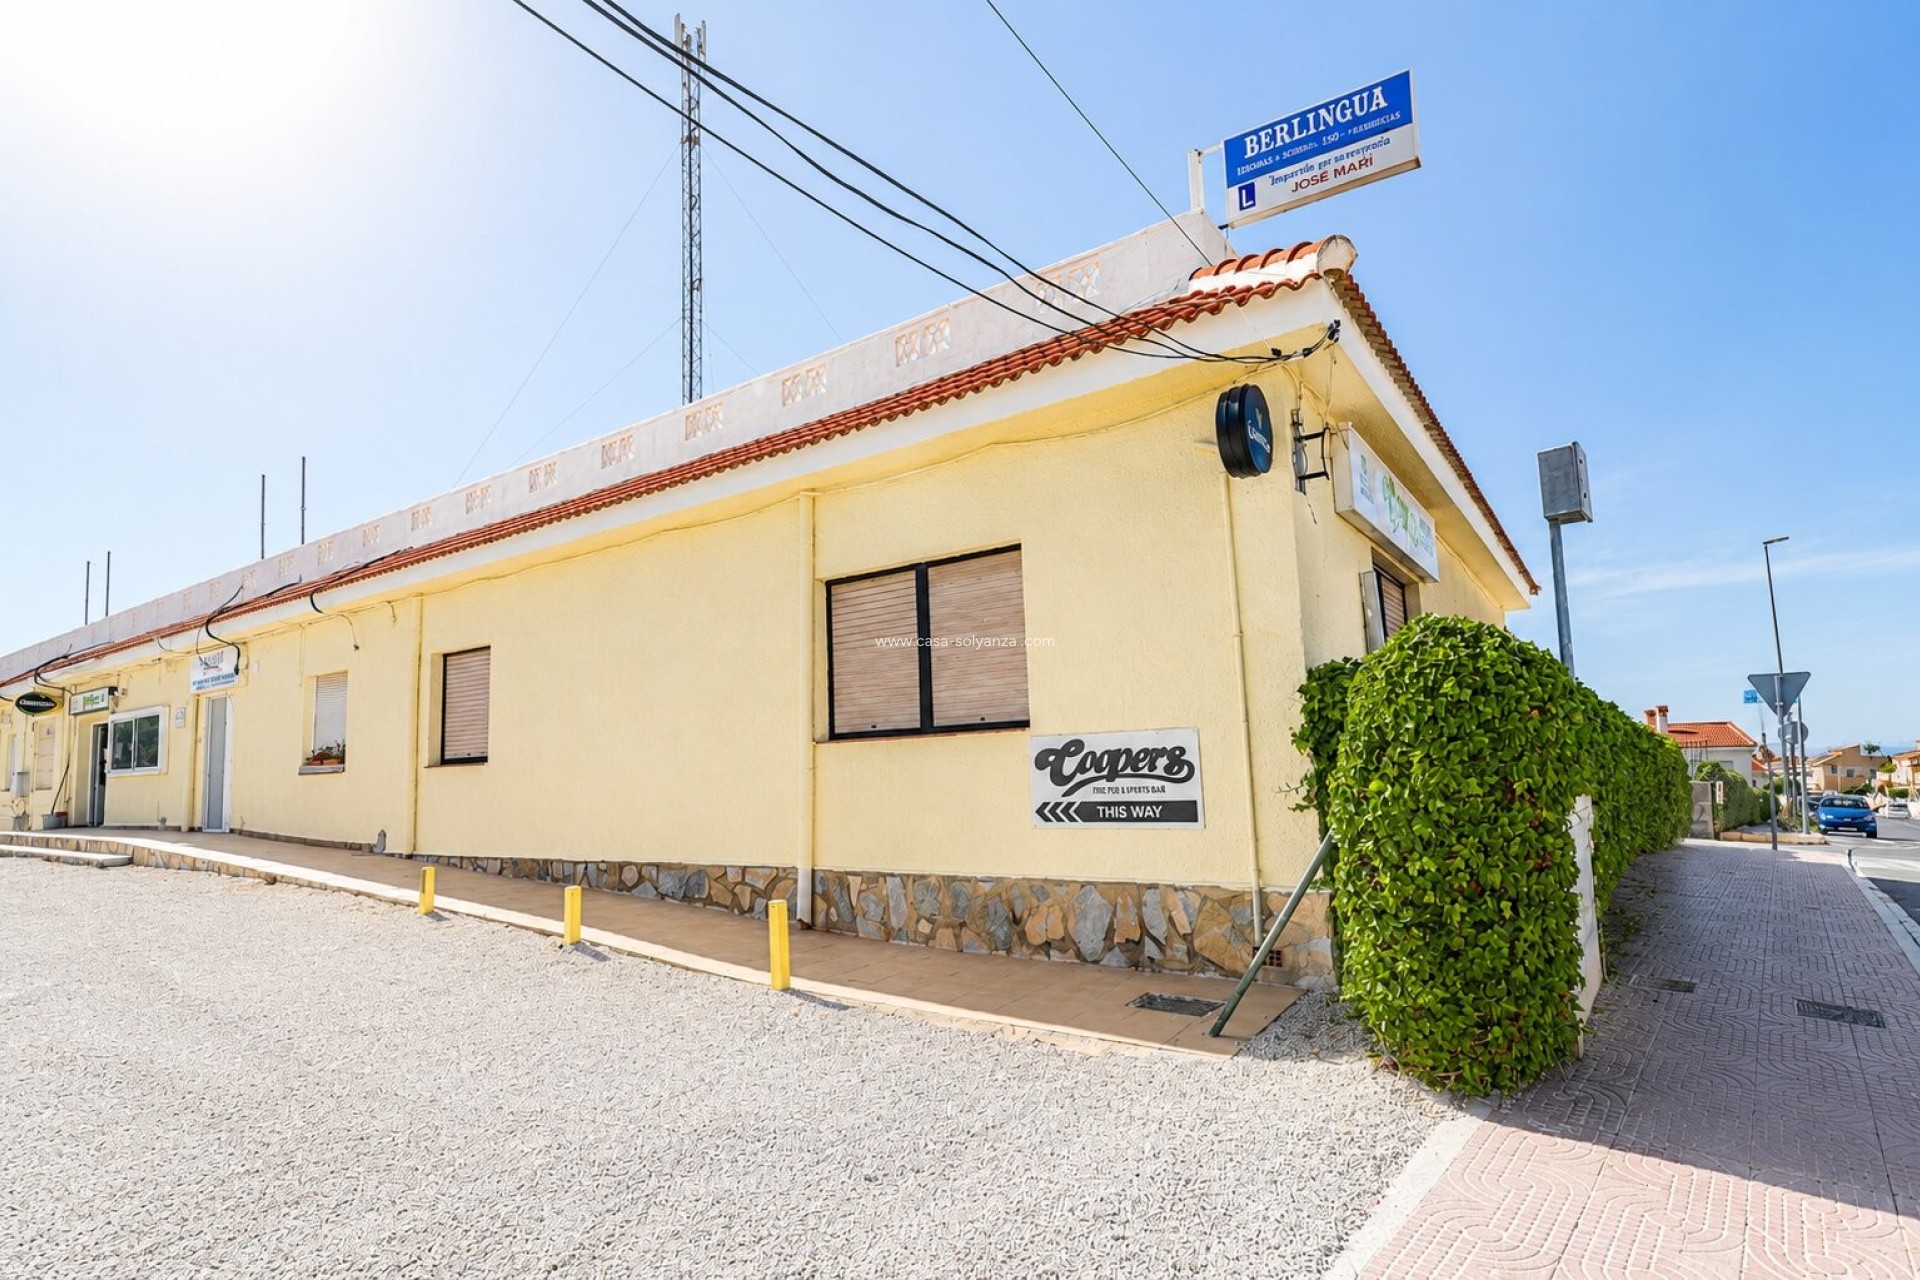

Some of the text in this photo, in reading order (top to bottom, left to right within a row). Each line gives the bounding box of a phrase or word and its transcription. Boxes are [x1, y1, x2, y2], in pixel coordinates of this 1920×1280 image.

[1244, 86, 1388, 159] BERLINGUA
[1241, 189, 1254, 208] L
[1034, 738, 1195, 796] Coopers
[1097, 805, 1163, 818] THIS WAY
